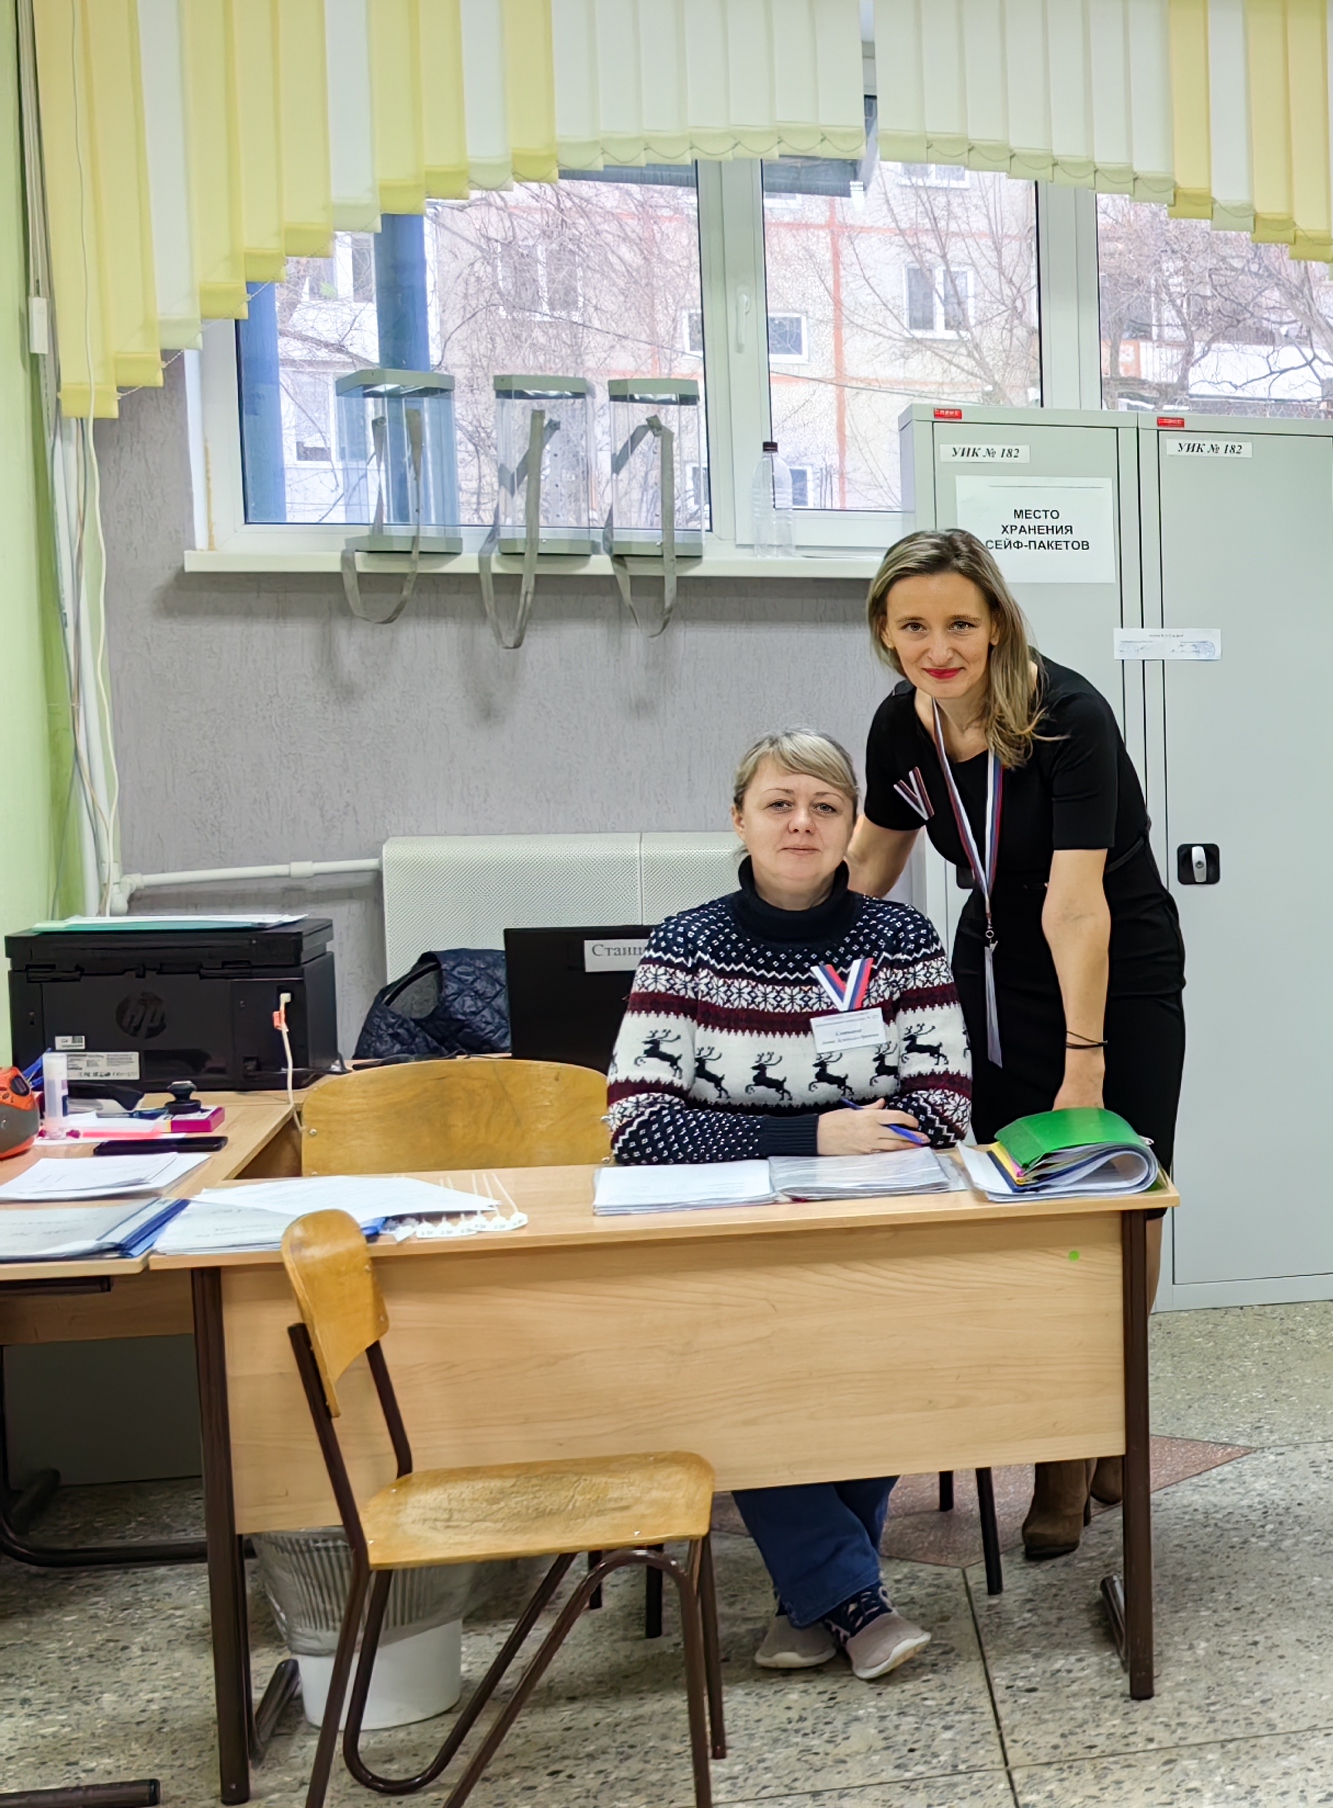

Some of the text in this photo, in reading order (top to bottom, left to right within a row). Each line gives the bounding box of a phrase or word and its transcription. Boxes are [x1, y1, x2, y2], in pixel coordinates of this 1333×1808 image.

[951, 446, 1020, 458] УИК № 182
[1177, 442, 1243, 455] УИК № 182
[1013, 509, 1060, 519] МЕСТО
[1001, 524, 1073, 535] ХРАНЕНИЯ
[985, 538, 1090, 551] СЕЙФ-ПАКЕТОВ
